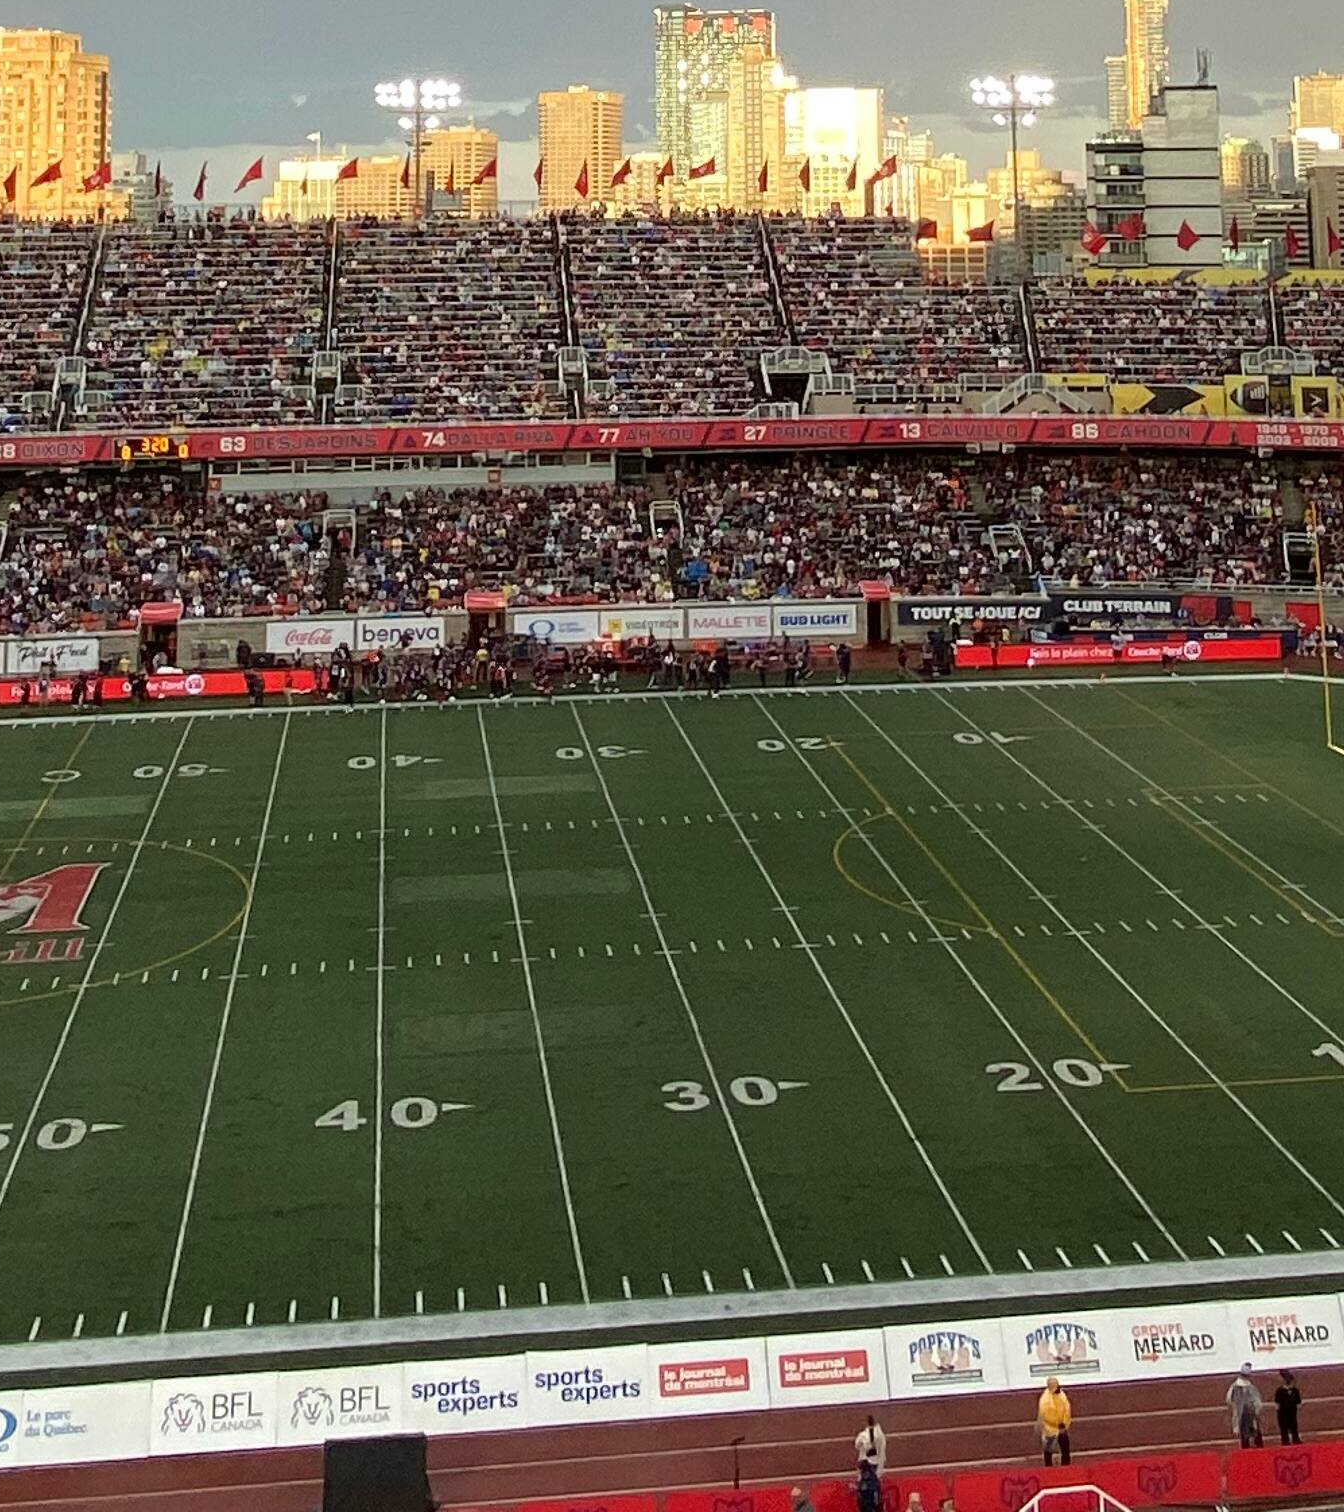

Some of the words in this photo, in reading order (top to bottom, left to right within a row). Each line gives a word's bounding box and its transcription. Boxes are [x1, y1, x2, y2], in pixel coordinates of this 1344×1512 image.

[598, 428, 620, 444] 77
[744, 426, 765, 441] 27
[772, 424, 849, 441] PRINGLE
[899, 423, 920, 439] 13
[928, 422, 1020, 439] CALVILLO
[254, 431, 376, 451] DESJARDINS
[422, 432, 446, 448] 74
[22, 441, 85, 458] DIXON
[911, 607, 952, 620] TOUT
[954, 606, 974, 619] SE
[975, 606, 1016, 619] JOUE
[1063, 599, 1103, 613] CLUB
[1104, 600, 1171, 613] TERRAIN
[780, 616, 808, 625] BUD
[810, 614, 848, 625] LIGHT
[362, 624, 439, 642] beneva
[985, 1058, 1109, 1093] 20
[660, 1075, 783, 1114] 30
[313, 1097, 442, 1132] 40
[1247, 1313, 1298, 1328] GROUPE
[1131, 1322, 1183, 1338] GROUPE
[784, 1361, 797, 1372] le
[799, 1357, 846, 1373] journal
[535, 1365, 603, 1391] sports
[663, 1370, 677, 1381] le
[679, 1366, 726, 1382] journal
[411, 1376, 481, 1403] sports
[561, 1379, 641, 1405] experts
[211, 1392, 263, 1419] BFL
[340, 1385, 391, 1414] BFL
[438, 1390, 519, 1417] experts
[210, 1418, 264, 1433] CANADA
[339, 1412, 391, 1427] CANADA
